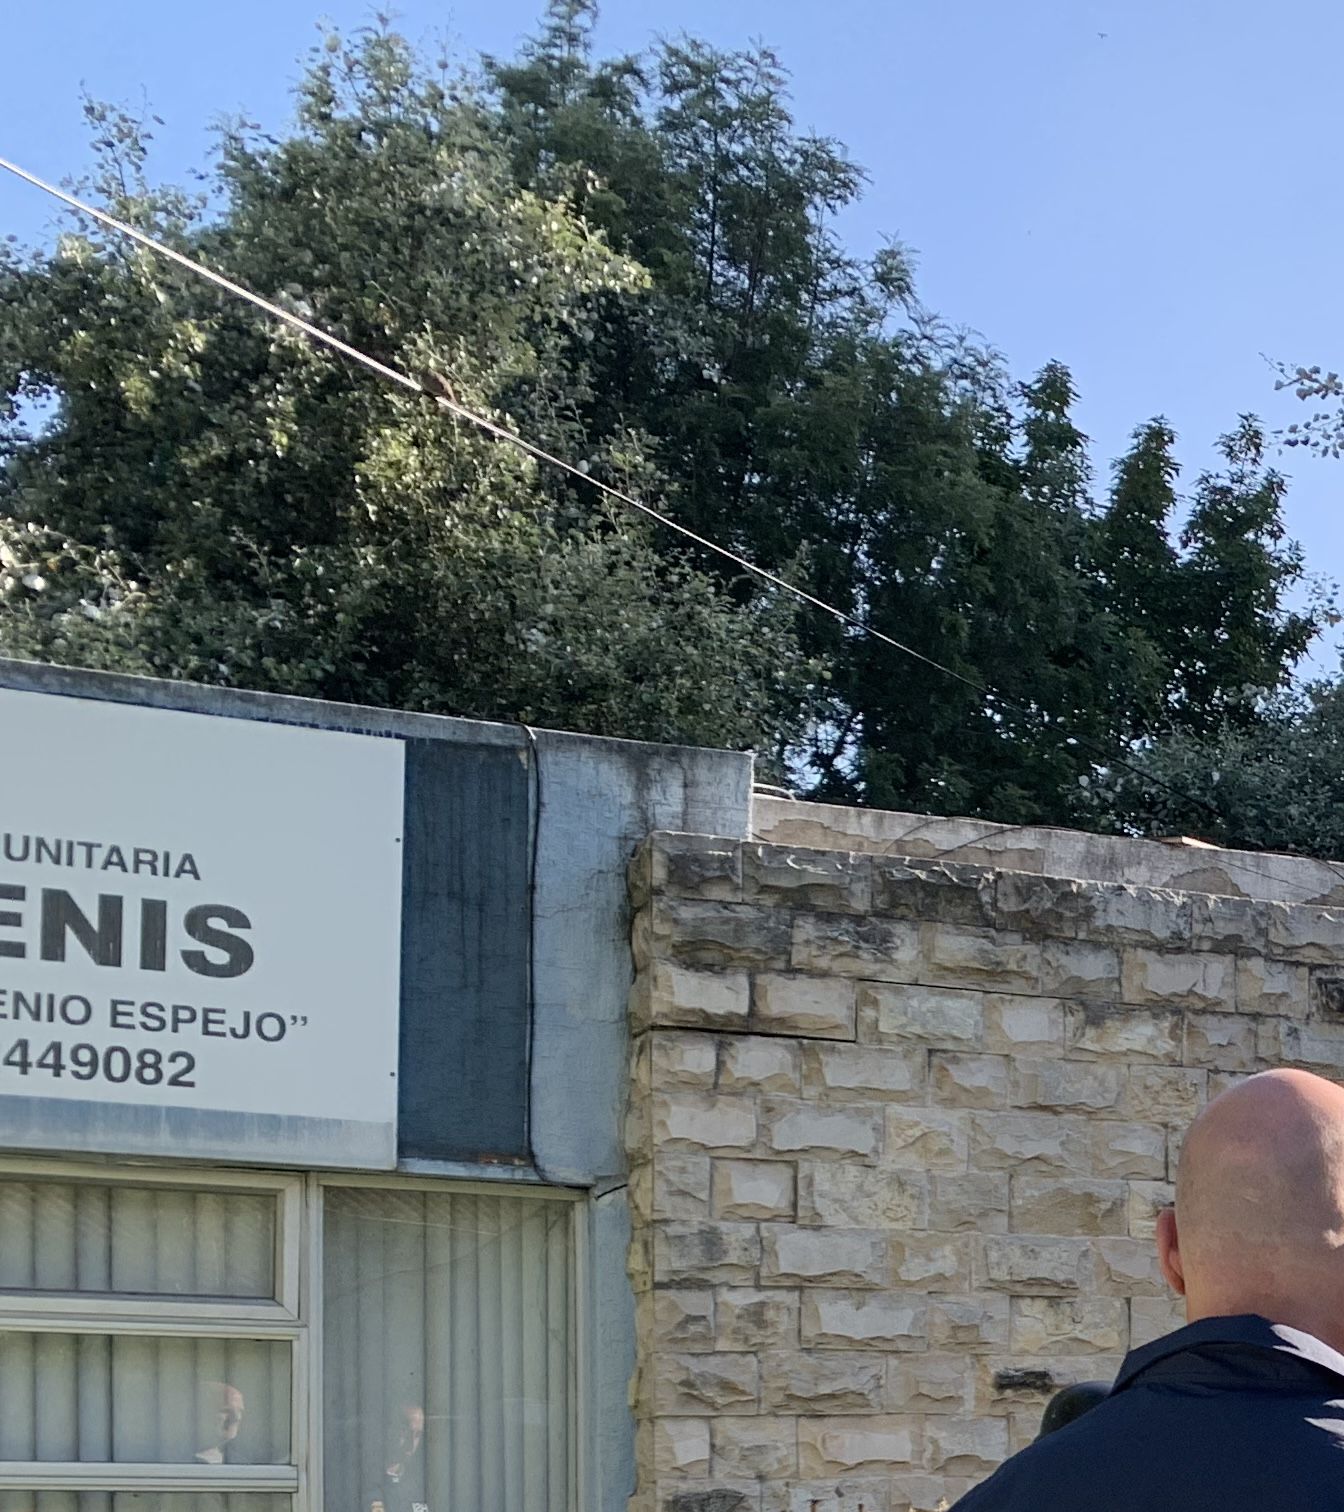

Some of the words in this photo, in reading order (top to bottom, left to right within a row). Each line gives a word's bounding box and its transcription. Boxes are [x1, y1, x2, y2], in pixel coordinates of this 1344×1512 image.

[3, 832, 202, 881] UNITARIA
[0, 988, 93, 1026] NIO
[3, 1038, 197, 1089] 449082
